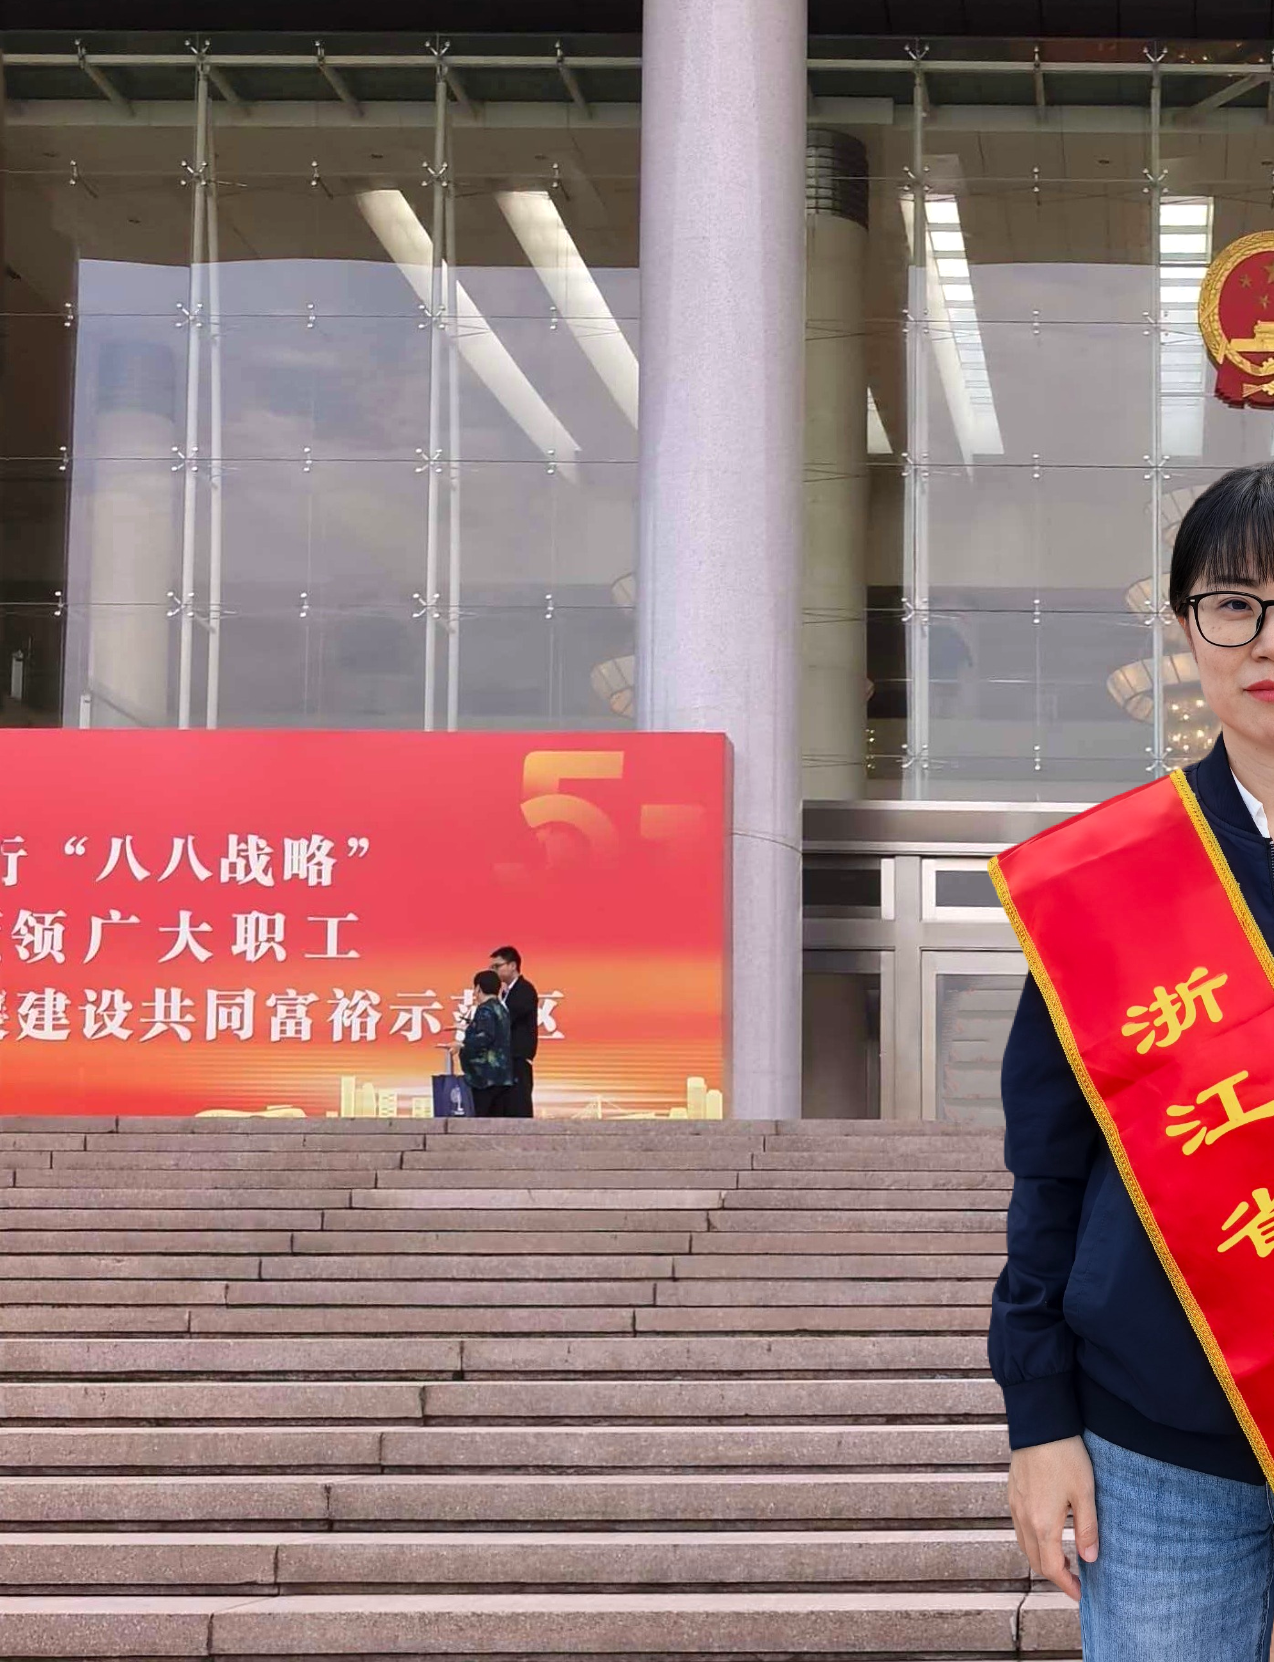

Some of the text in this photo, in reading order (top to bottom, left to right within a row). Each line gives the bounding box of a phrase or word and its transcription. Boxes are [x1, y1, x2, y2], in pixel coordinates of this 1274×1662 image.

[0, 909, 361, 965] 领广大职工
[0, 987, 566, 1043] 建设共同富裕示区
